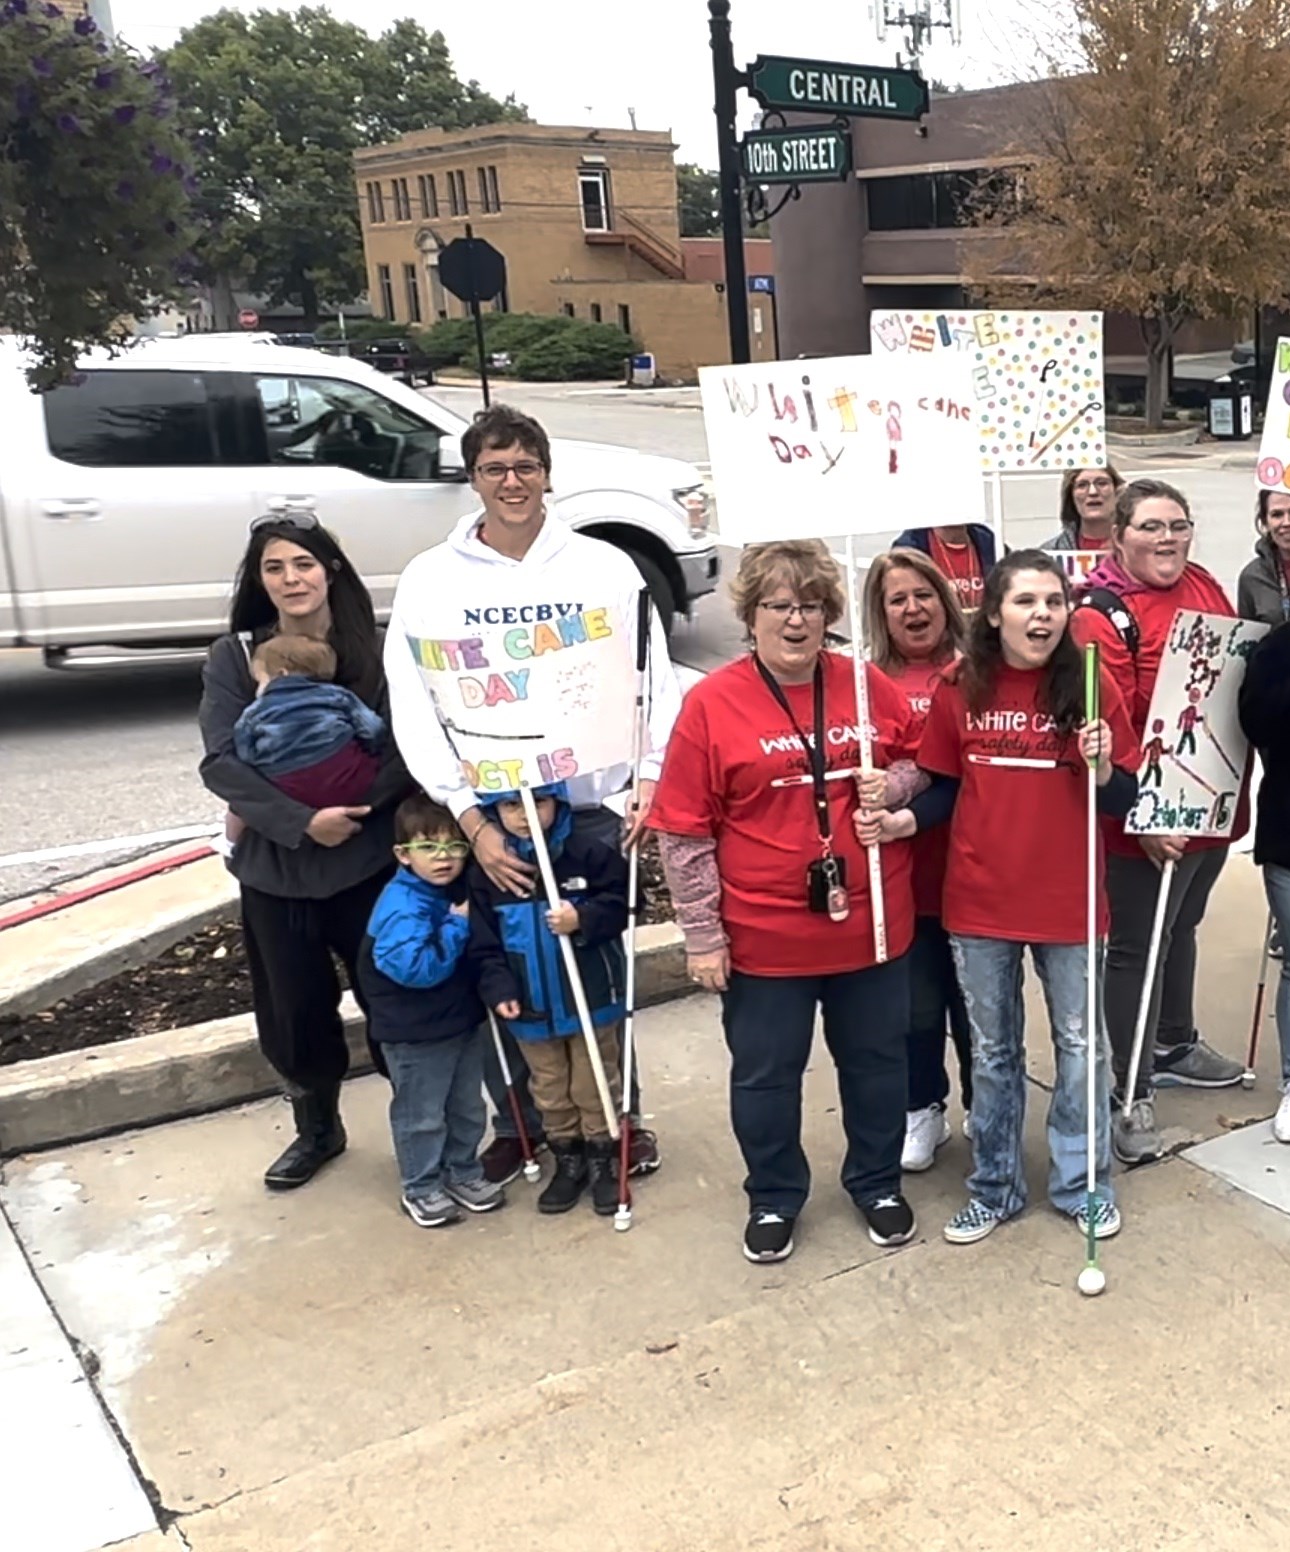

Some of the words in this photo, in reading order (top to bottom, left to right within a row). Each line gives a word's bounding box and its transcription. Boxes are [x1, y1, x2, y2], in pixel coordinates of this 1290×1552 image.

[789, 69, 897, 108] CENTRAL
[747, 142, 778, 174] 10th
[782, 137, 837, 172] STREET
[872, 312, 1000, 354] WHITE
[767, 432, 846, 475] Day
[503, 607, 612, 660] CANE
[457, 667, 531, 708] DAY
